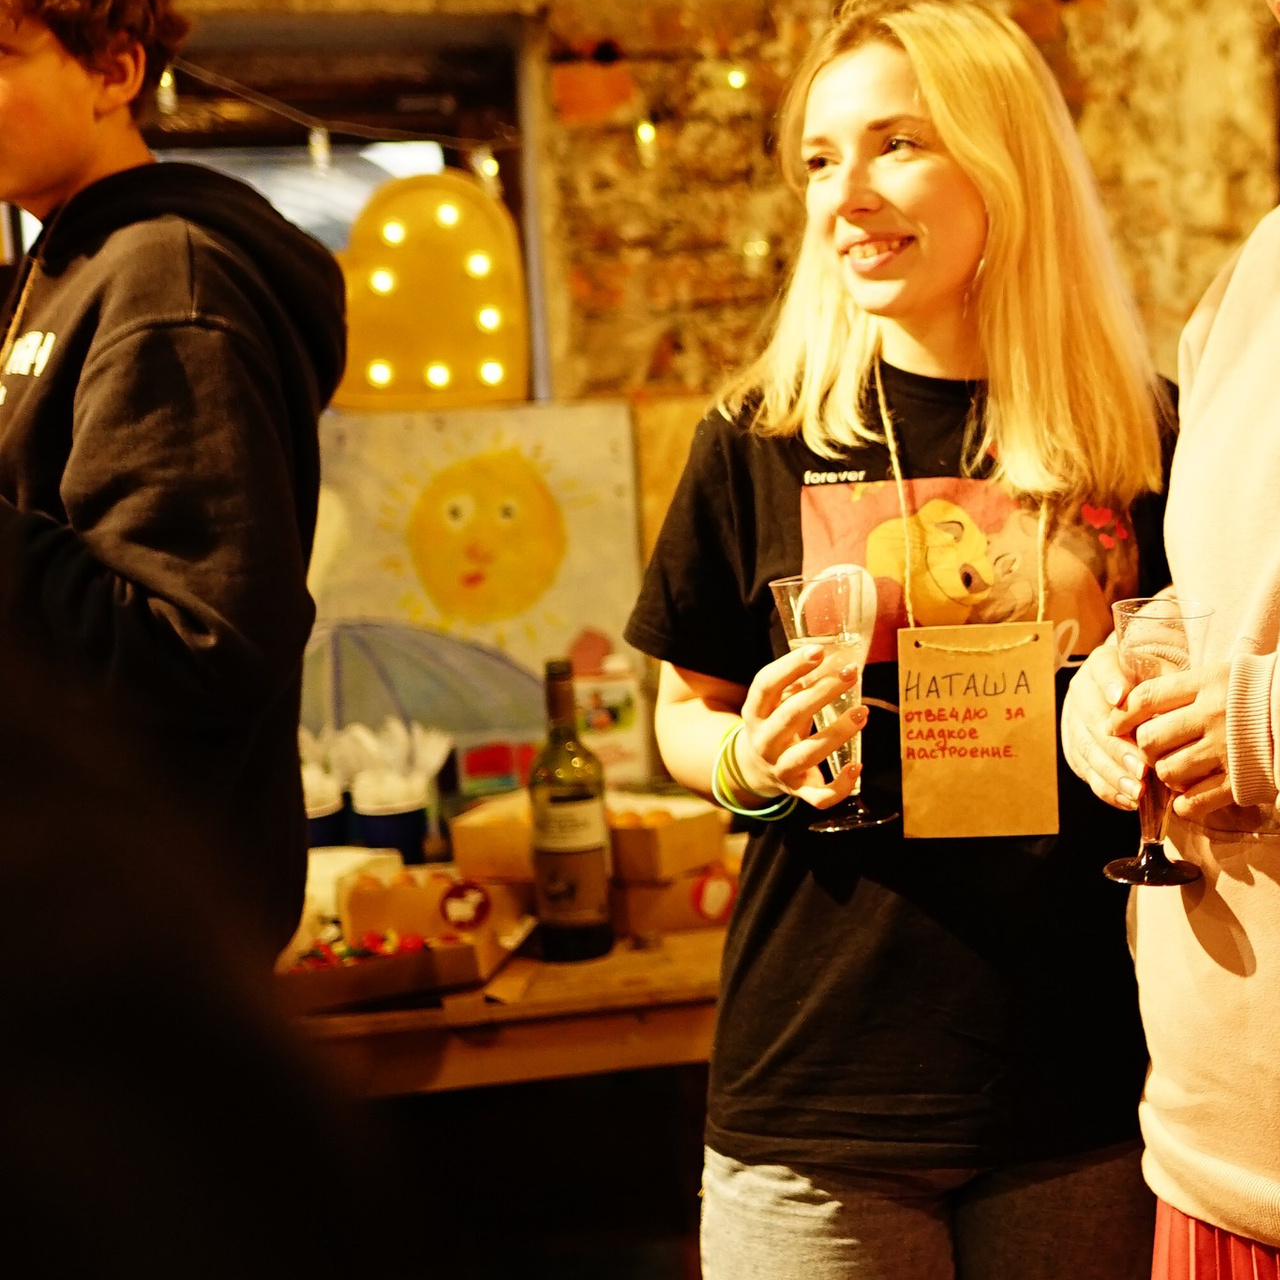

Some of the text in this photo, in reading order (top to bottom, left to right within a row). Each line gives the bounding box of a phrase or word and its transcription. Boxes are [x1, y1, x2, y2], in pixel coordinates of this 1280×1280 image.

[804, 470, 866, 484] forever
[905, 670, 1031, 702] НАТАША
[904, 707, 1026, 723] ОТВЕЧАЮ ЗА
